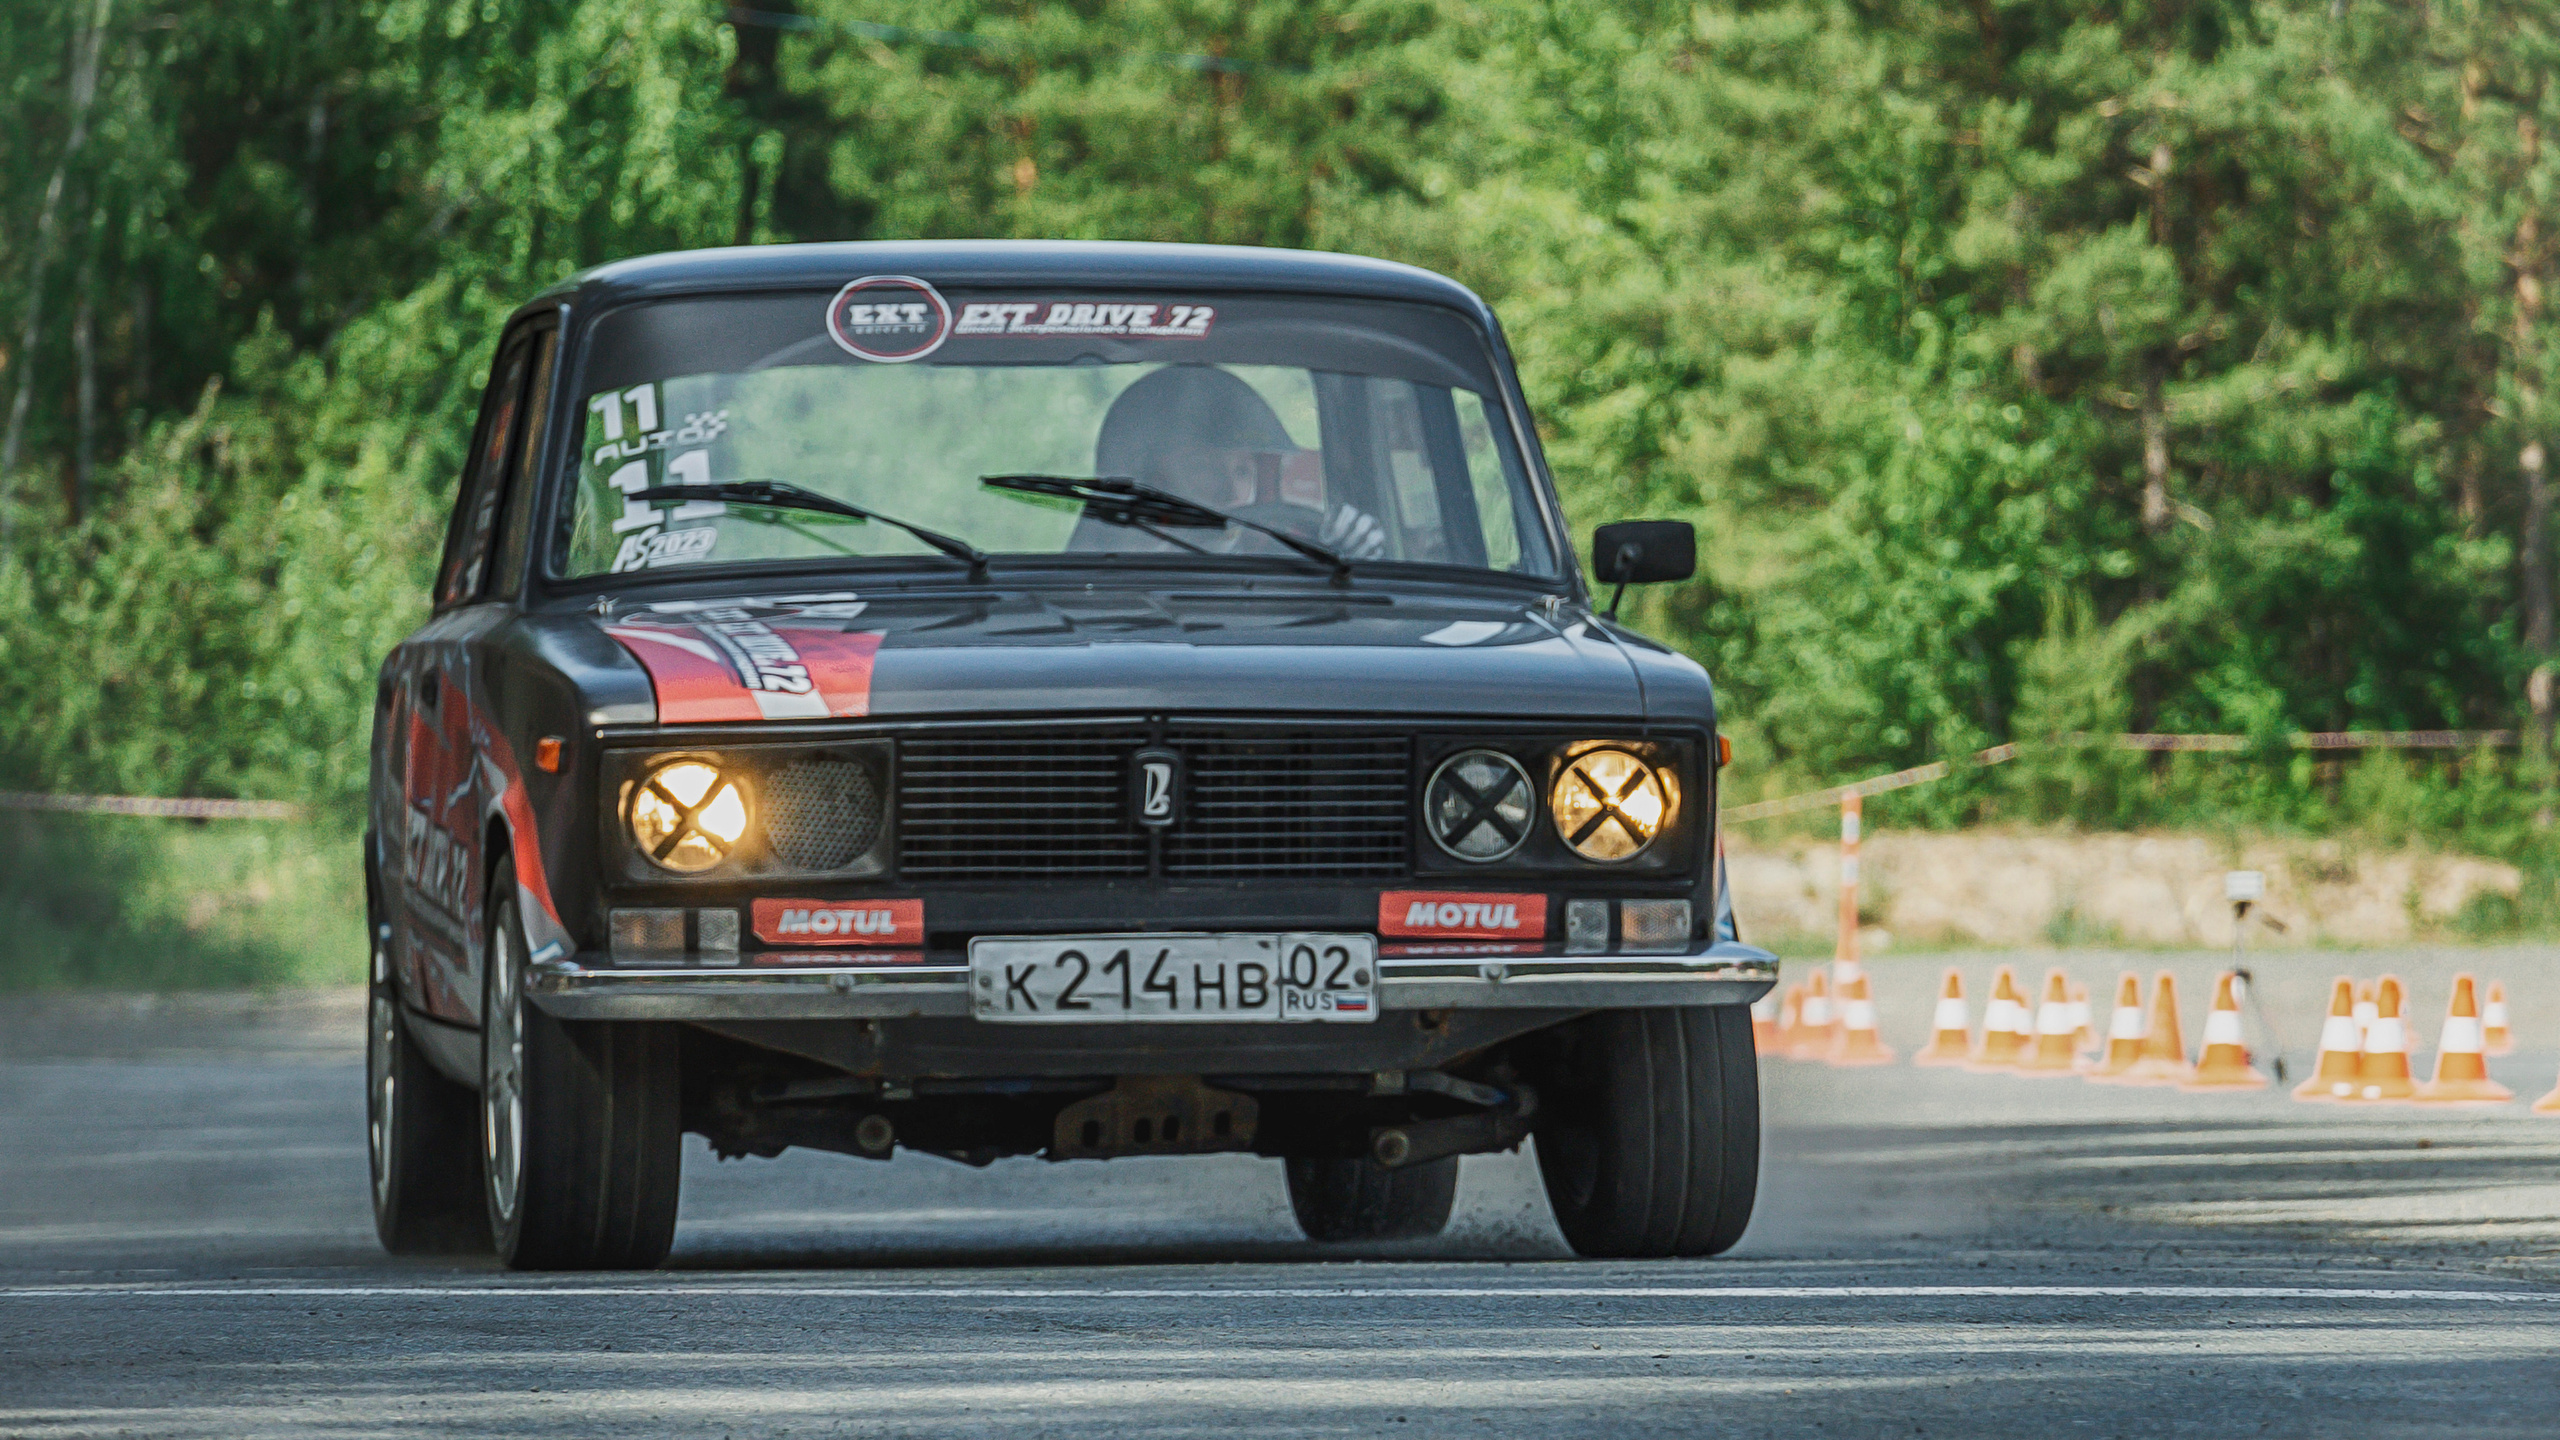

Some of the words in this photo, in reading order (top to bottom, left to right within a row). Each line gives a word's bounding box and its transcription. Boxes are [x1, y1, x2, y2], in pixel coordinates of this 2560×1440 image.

[849, 303, 928, 325] EXT
[958, 303, 1038, 326] EXT
[1044, 303, 1159, 327] DRIVE
[1169, 305, 1214, 329] 72
[590, 383, 659, 441] 11
[609, 449, 727, 534] 11
[777, 909, 898, 935] MOTUL
[1405, 902, 1521, 929] MOTUL
[1290, 944, 1350, 991] 02
[1286, 990, 1333, 1011] RUS
